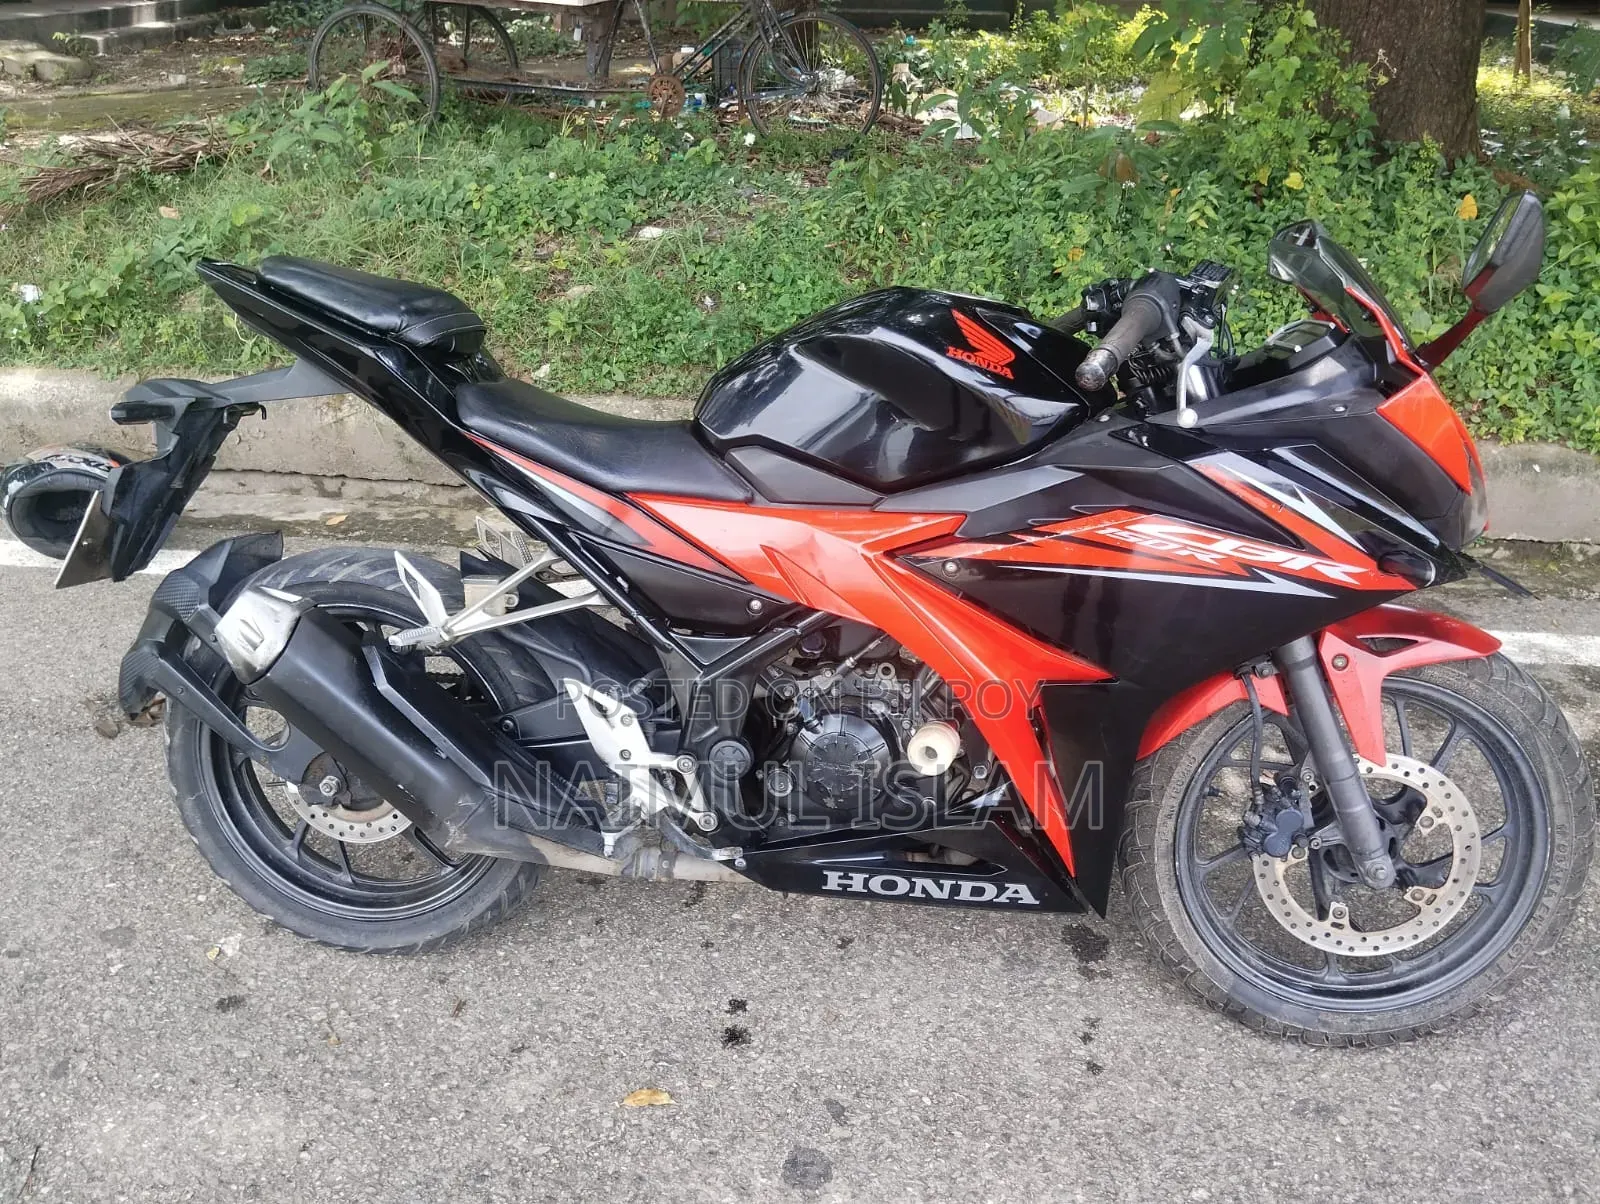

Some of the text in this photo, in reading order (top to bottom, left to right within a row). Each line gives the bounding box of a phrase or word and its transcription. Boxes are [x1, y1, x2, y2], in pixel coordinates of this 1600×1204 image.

[945, 346, 1015, 380] HONDA
[1123, 523, 1370, 585] CBR
[821, 869, 1041, 905] HONDA
